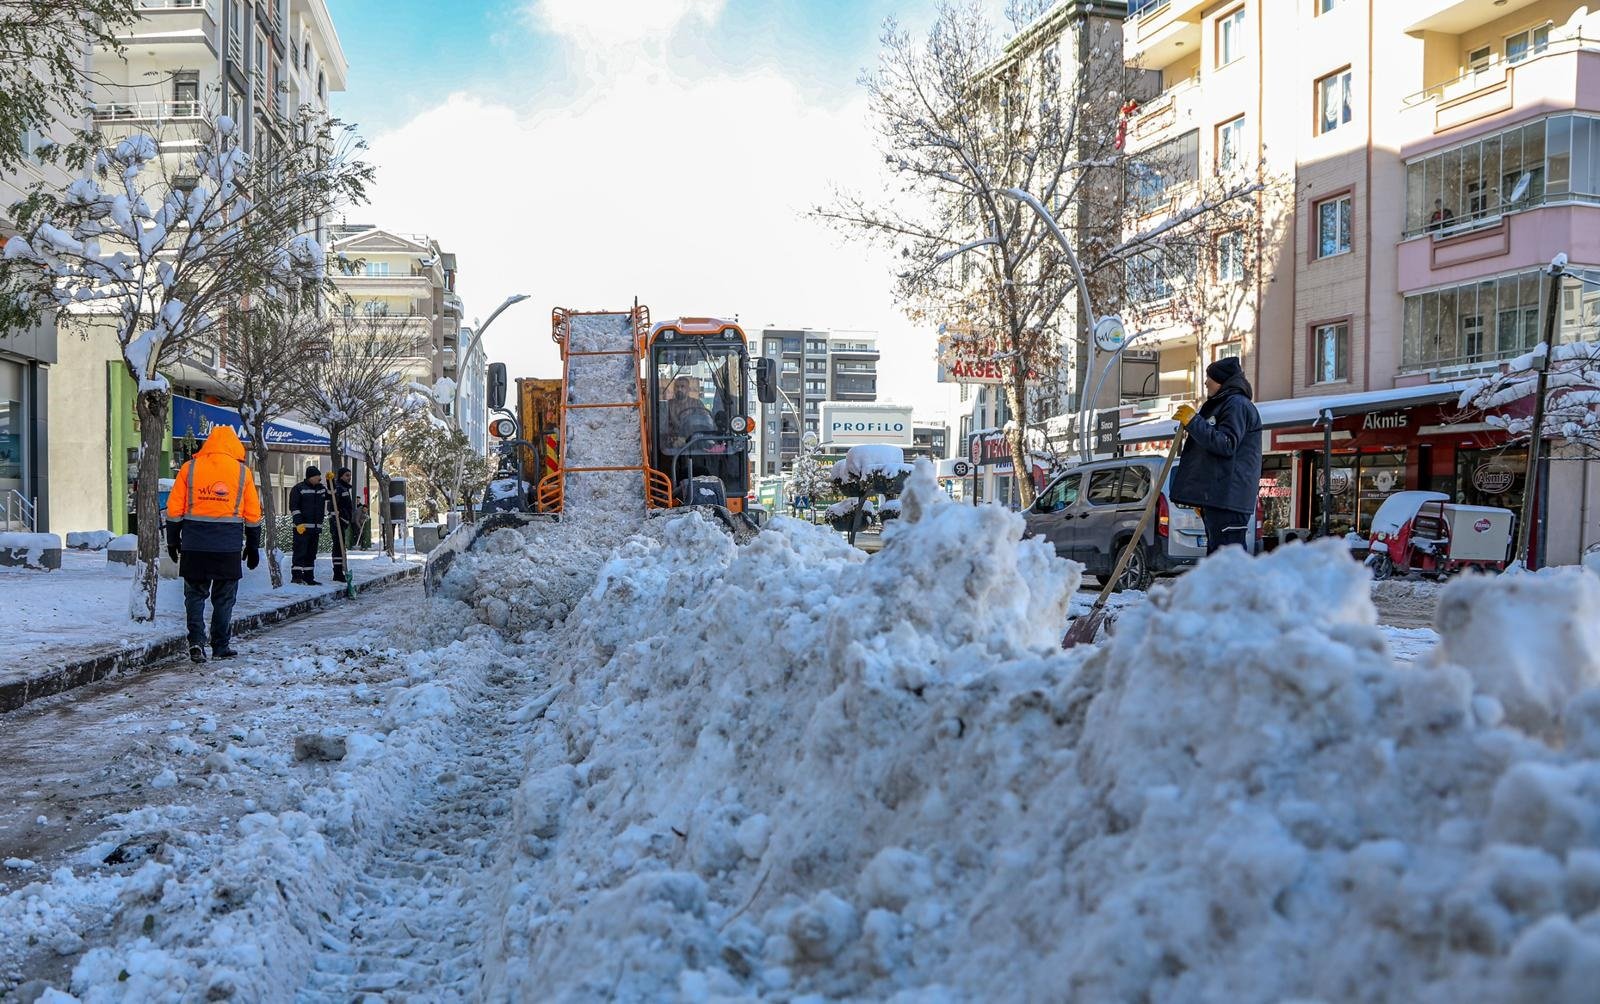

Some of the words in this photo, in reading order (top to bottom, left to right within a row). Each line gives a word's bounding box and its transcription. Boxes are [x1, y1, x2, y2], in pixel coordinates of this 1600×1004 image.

[1101, 421, 1113, 430] Since
[1362, 412, 1407, 429] Akmis
[265, 426, 293, 440] finger
[1476, 471, 1511, 483] Akmis
